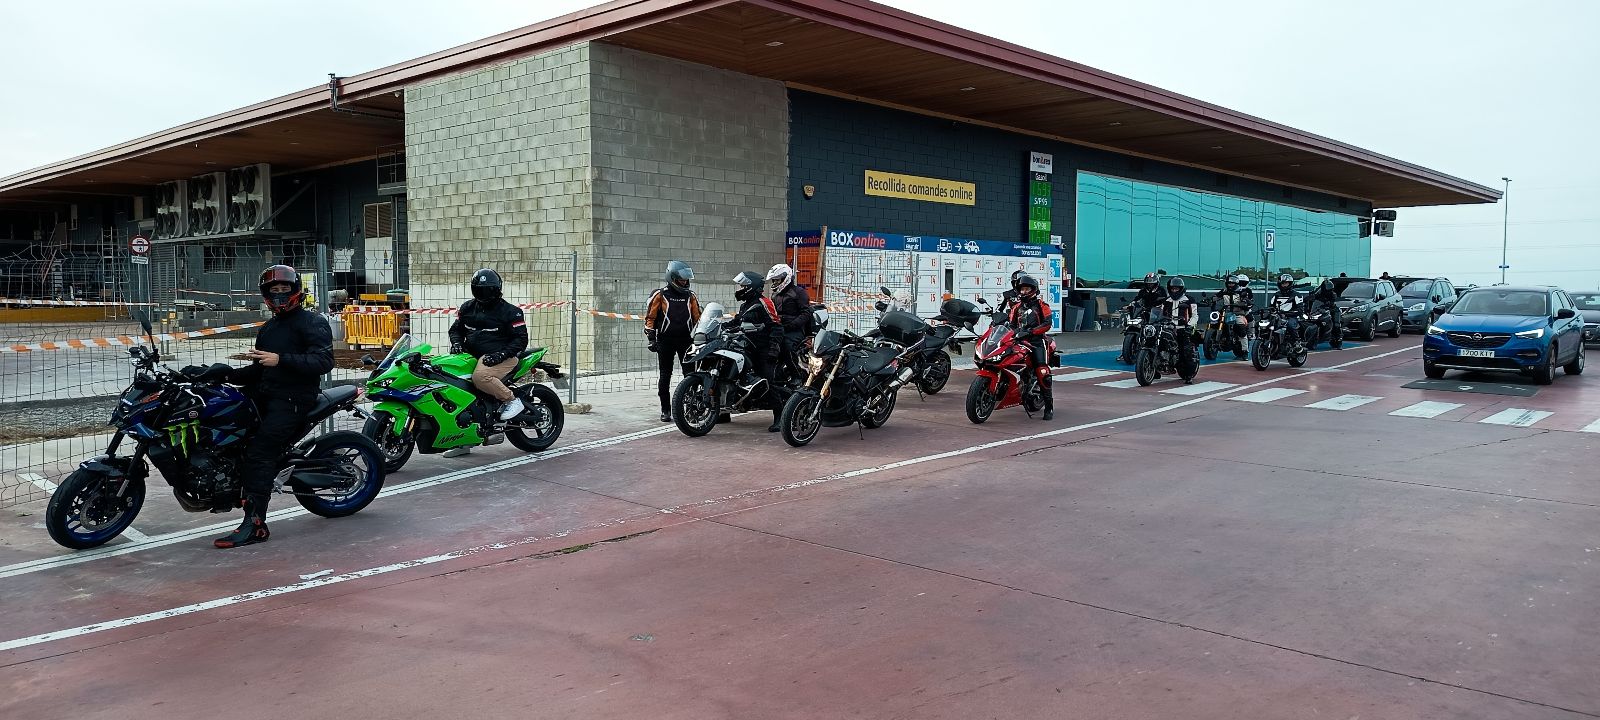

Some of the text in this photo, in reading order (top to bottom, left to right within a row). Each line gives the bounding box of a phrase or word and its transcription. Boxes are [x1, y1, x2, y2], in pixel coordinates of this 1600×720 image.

[868, 176, 973, 201] Recollida comandes online
[788, 235, 821, 245] BOX onlin
[831, 231, 854, 246] BOX
[854, 231, 886, 248] online
